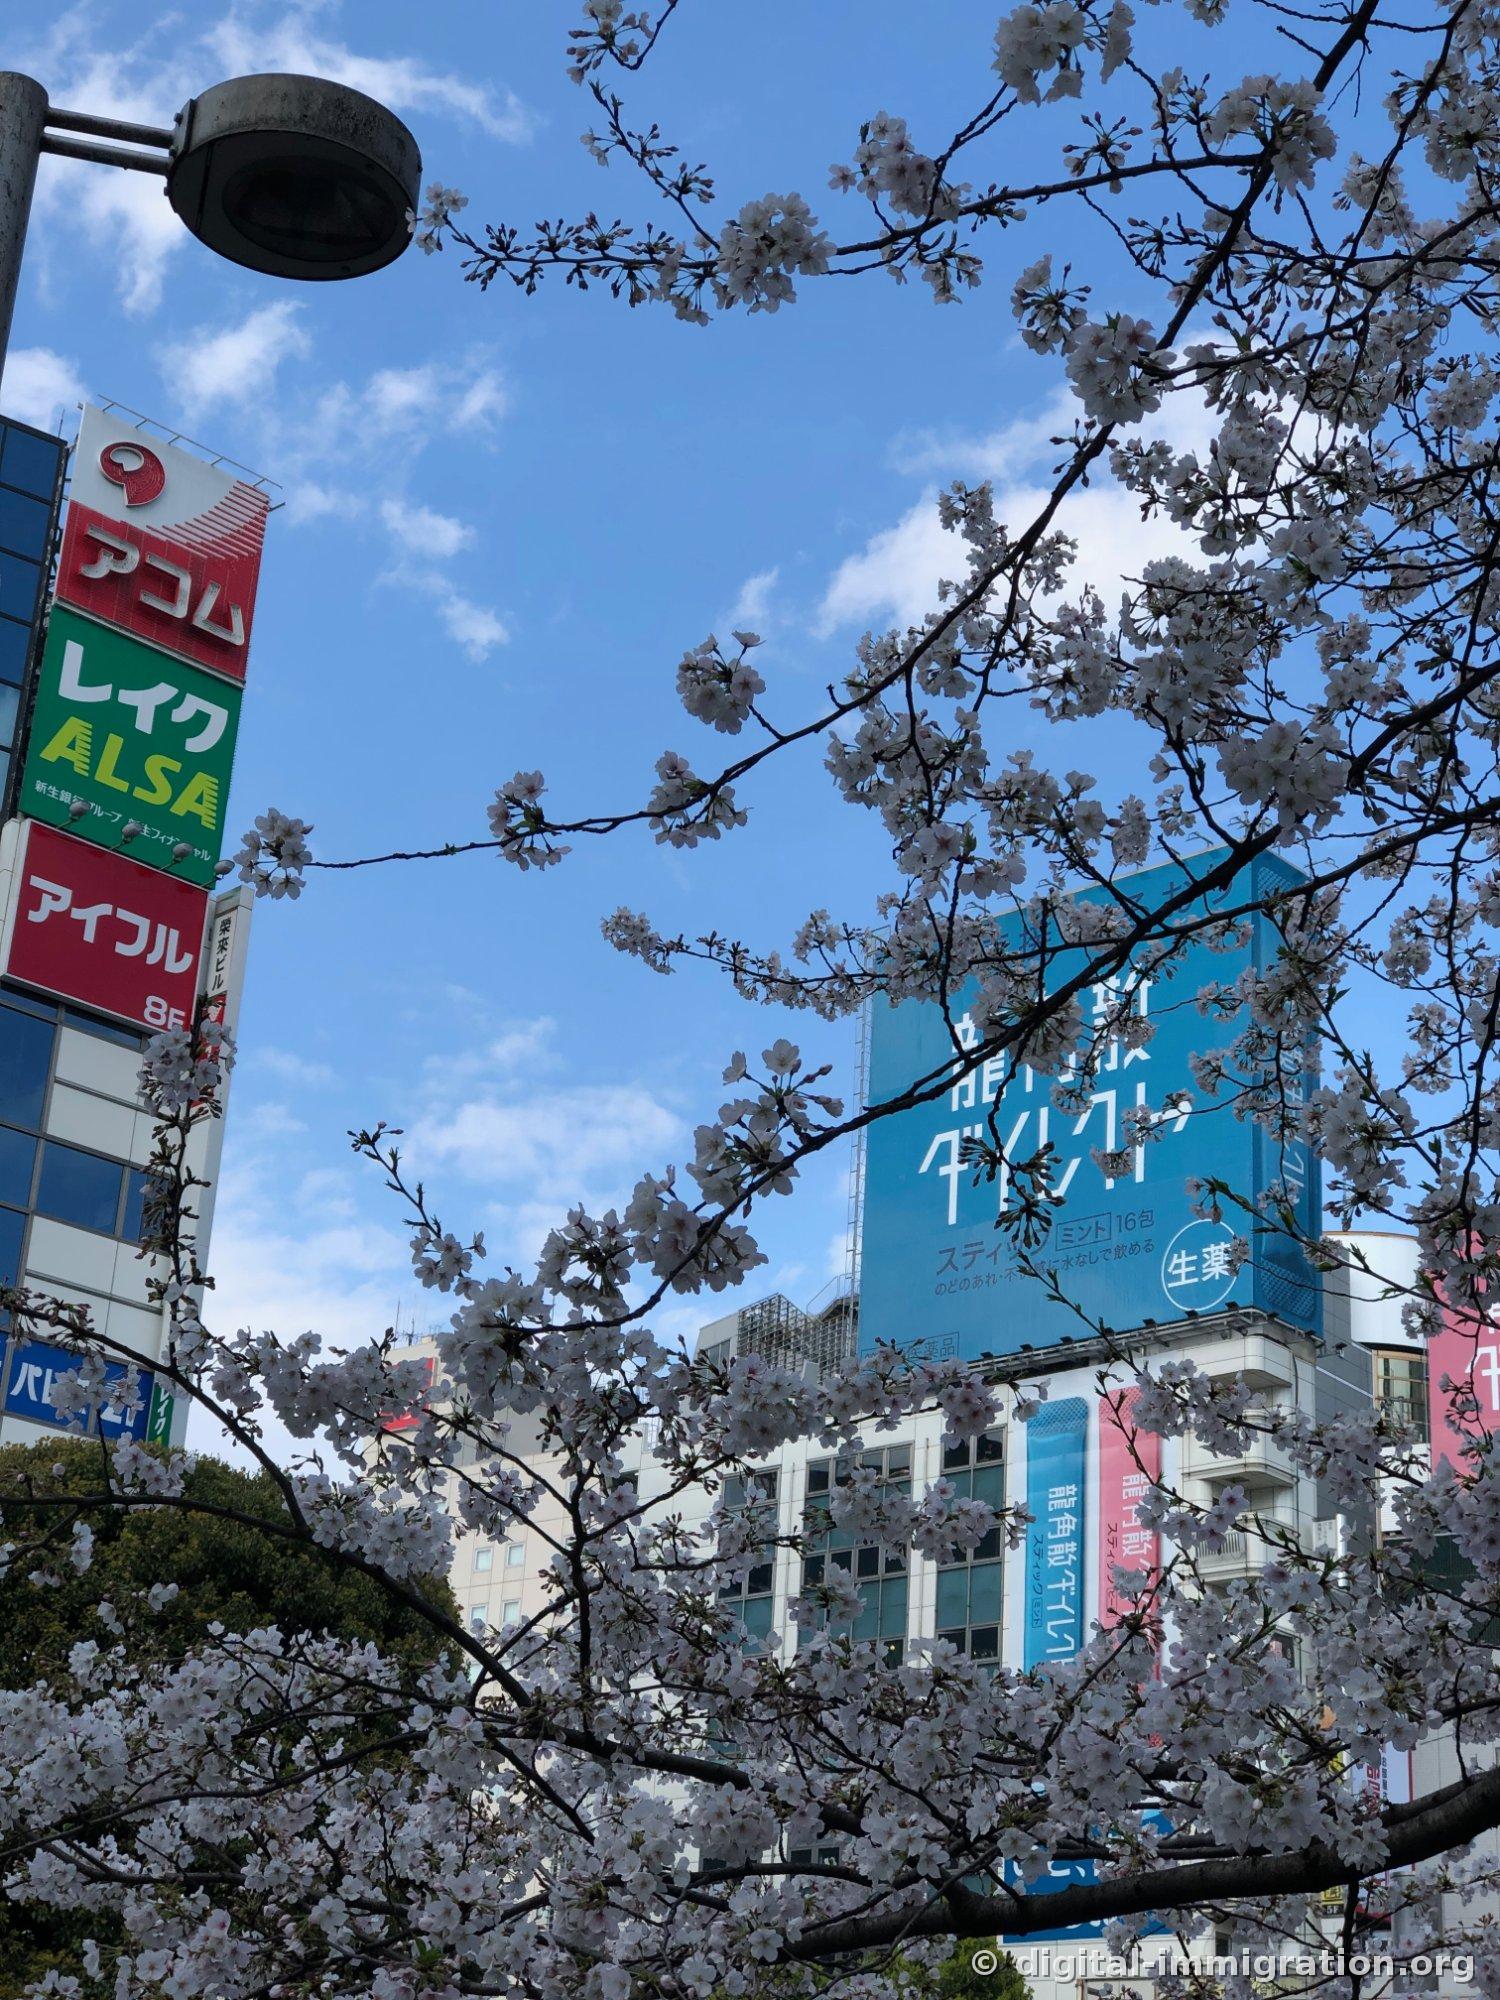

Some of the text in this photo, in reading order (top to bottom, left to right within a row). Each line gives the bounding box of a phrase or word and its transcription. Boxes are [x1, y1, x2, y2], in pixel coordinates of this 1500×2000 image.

[80, 523, 245, 646] アコム
[58, 639, 229, 753] レイク
[39, 715, 219, 830] ALSA
[128, 818, 211, 861] 生フィナャル
[28, 874, 194, 975] アイフル
[143, 994, 186, 1031] 8F
[919, 1081, 1193, 1226] ダイレクト
[935, 1238, 1155, 1296] のどのあれ・不感に水なしで飲める
[1061, 1220, 1107, 1244] ミント
[1116, 1209, 1155, 1233] 16包
[1167, 1242, 1232, 1288] 生薬
[1032, 1534, 1044, 1627] スティック ミント
